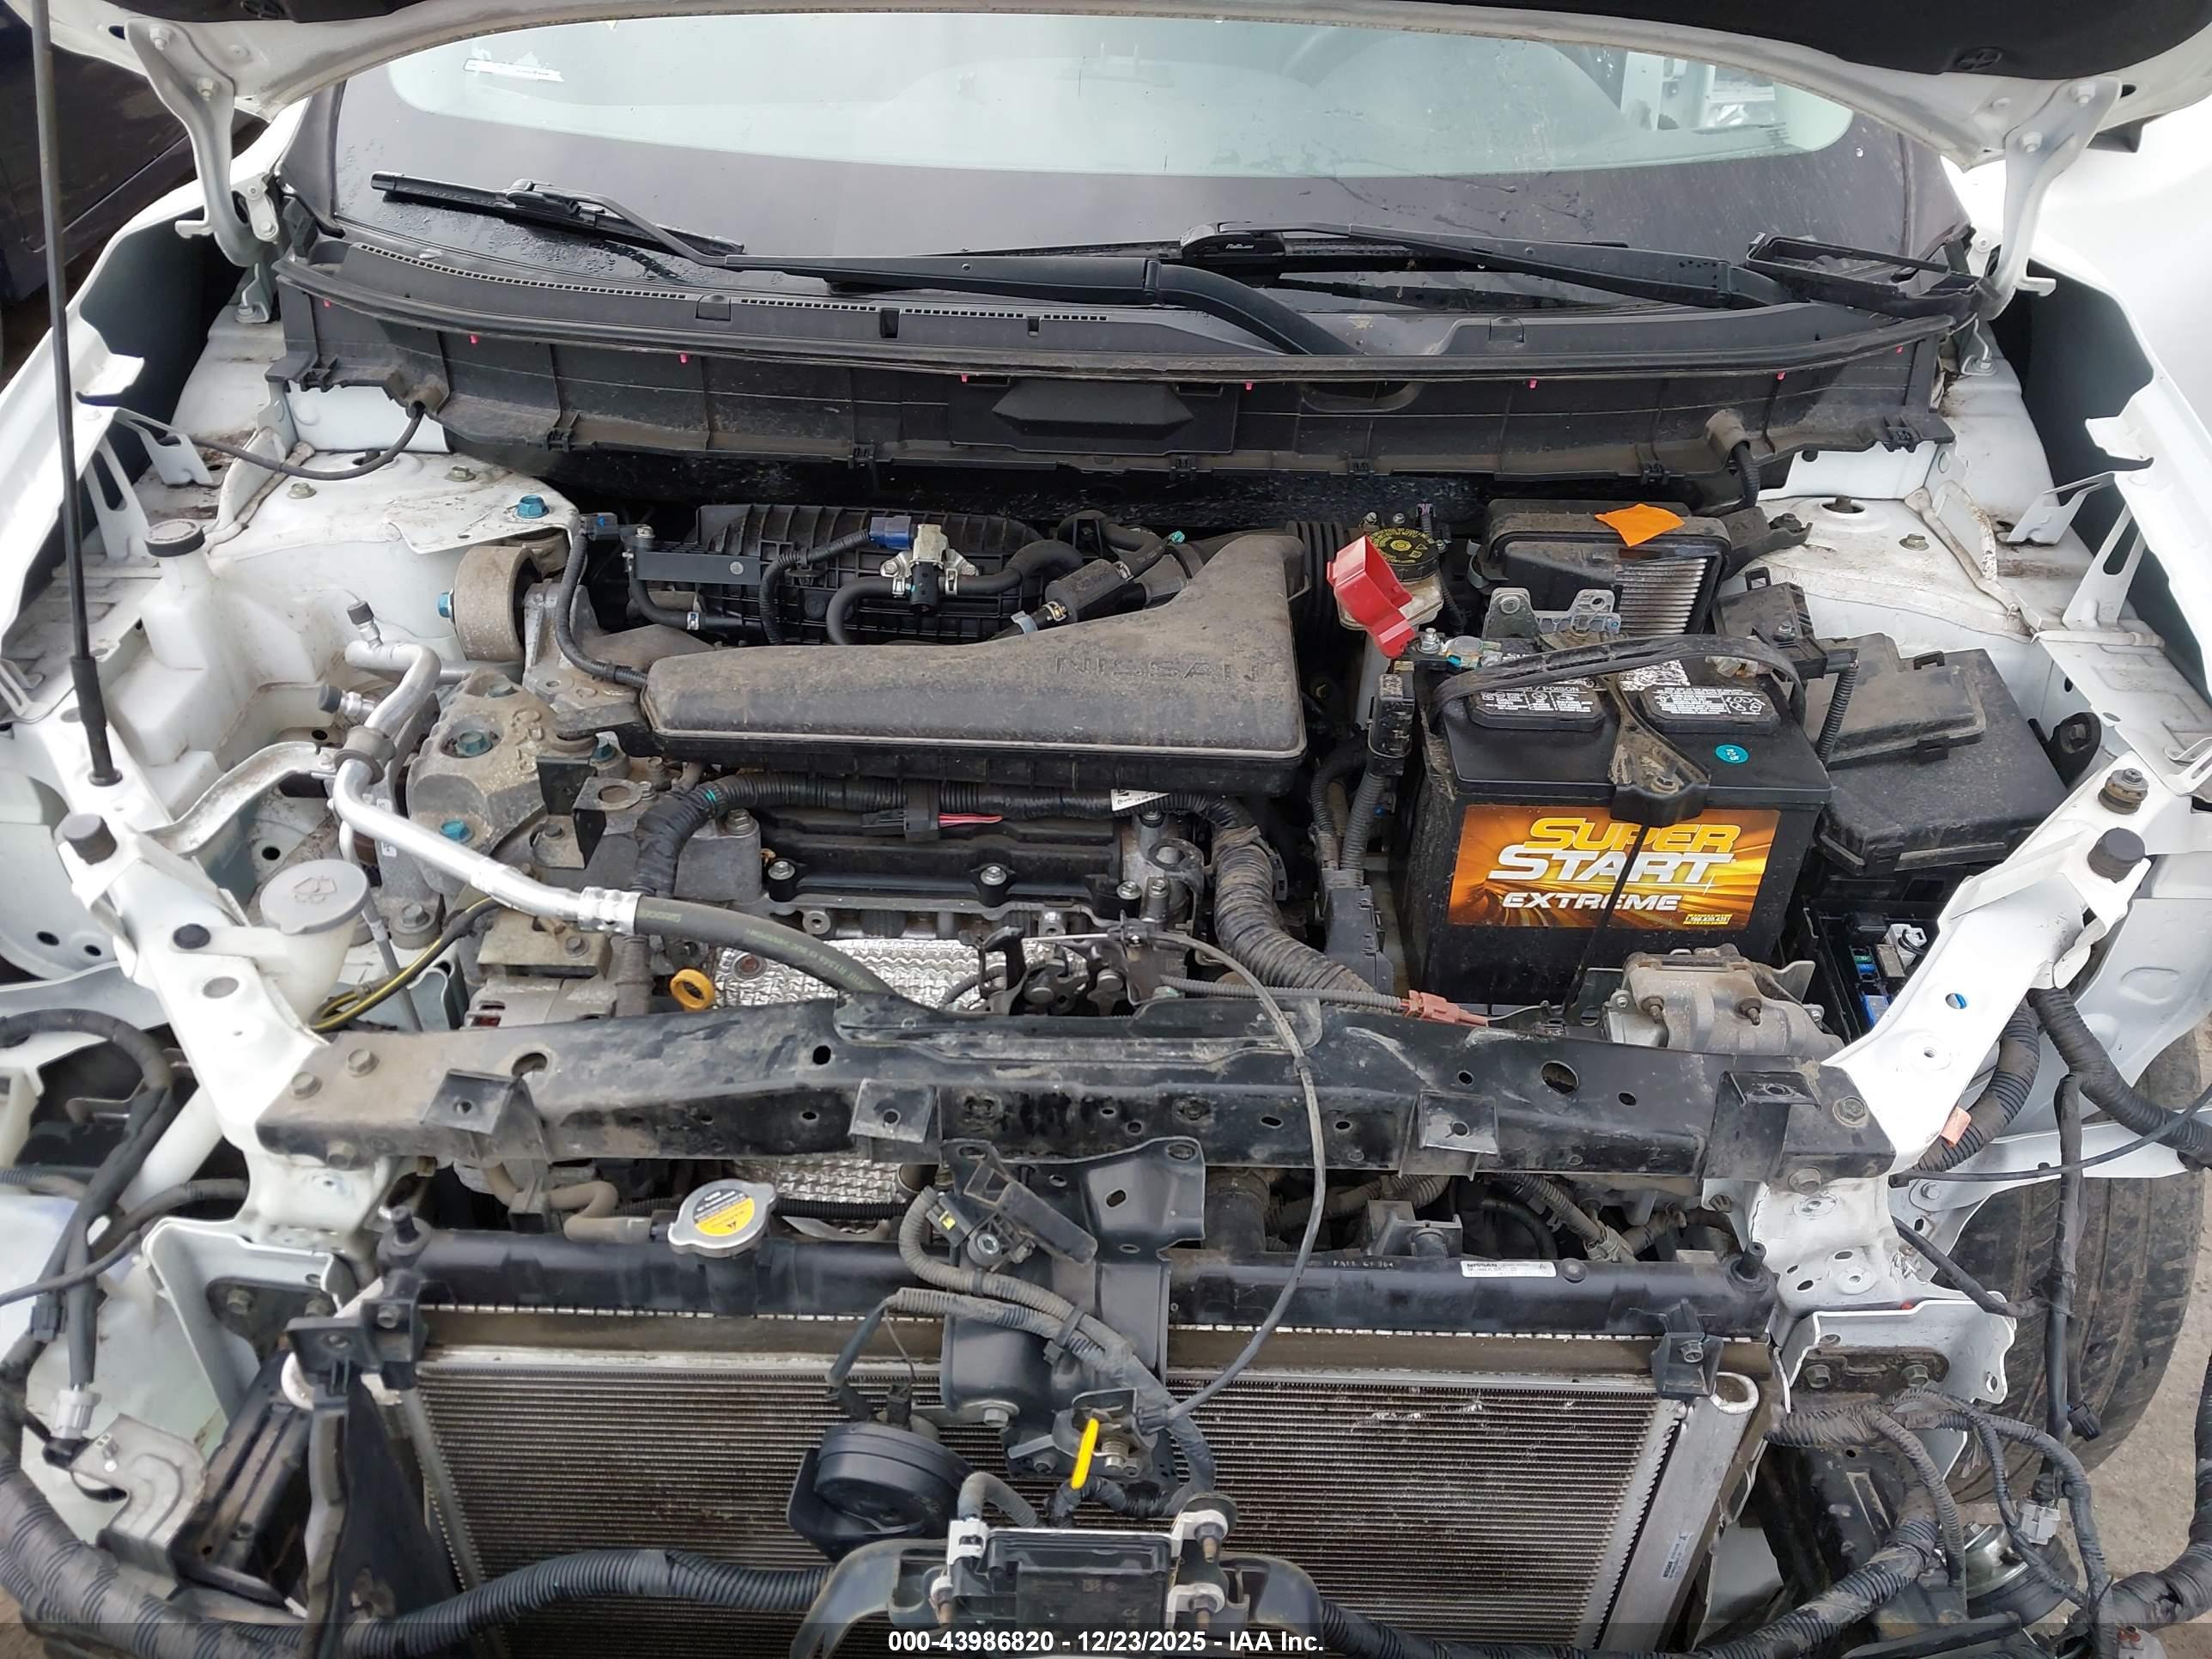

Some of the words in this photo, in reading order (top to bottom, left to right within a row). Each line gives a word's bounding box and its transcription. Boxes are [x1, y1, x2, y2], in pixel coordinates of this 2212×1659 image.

[1055, 655, 1260, 683] NISSAN
[1523, 817, 1741, 853] SUPER
[1487, 844, 1735, 884] START
[1502, 891, 1684, 912] EXTREME
